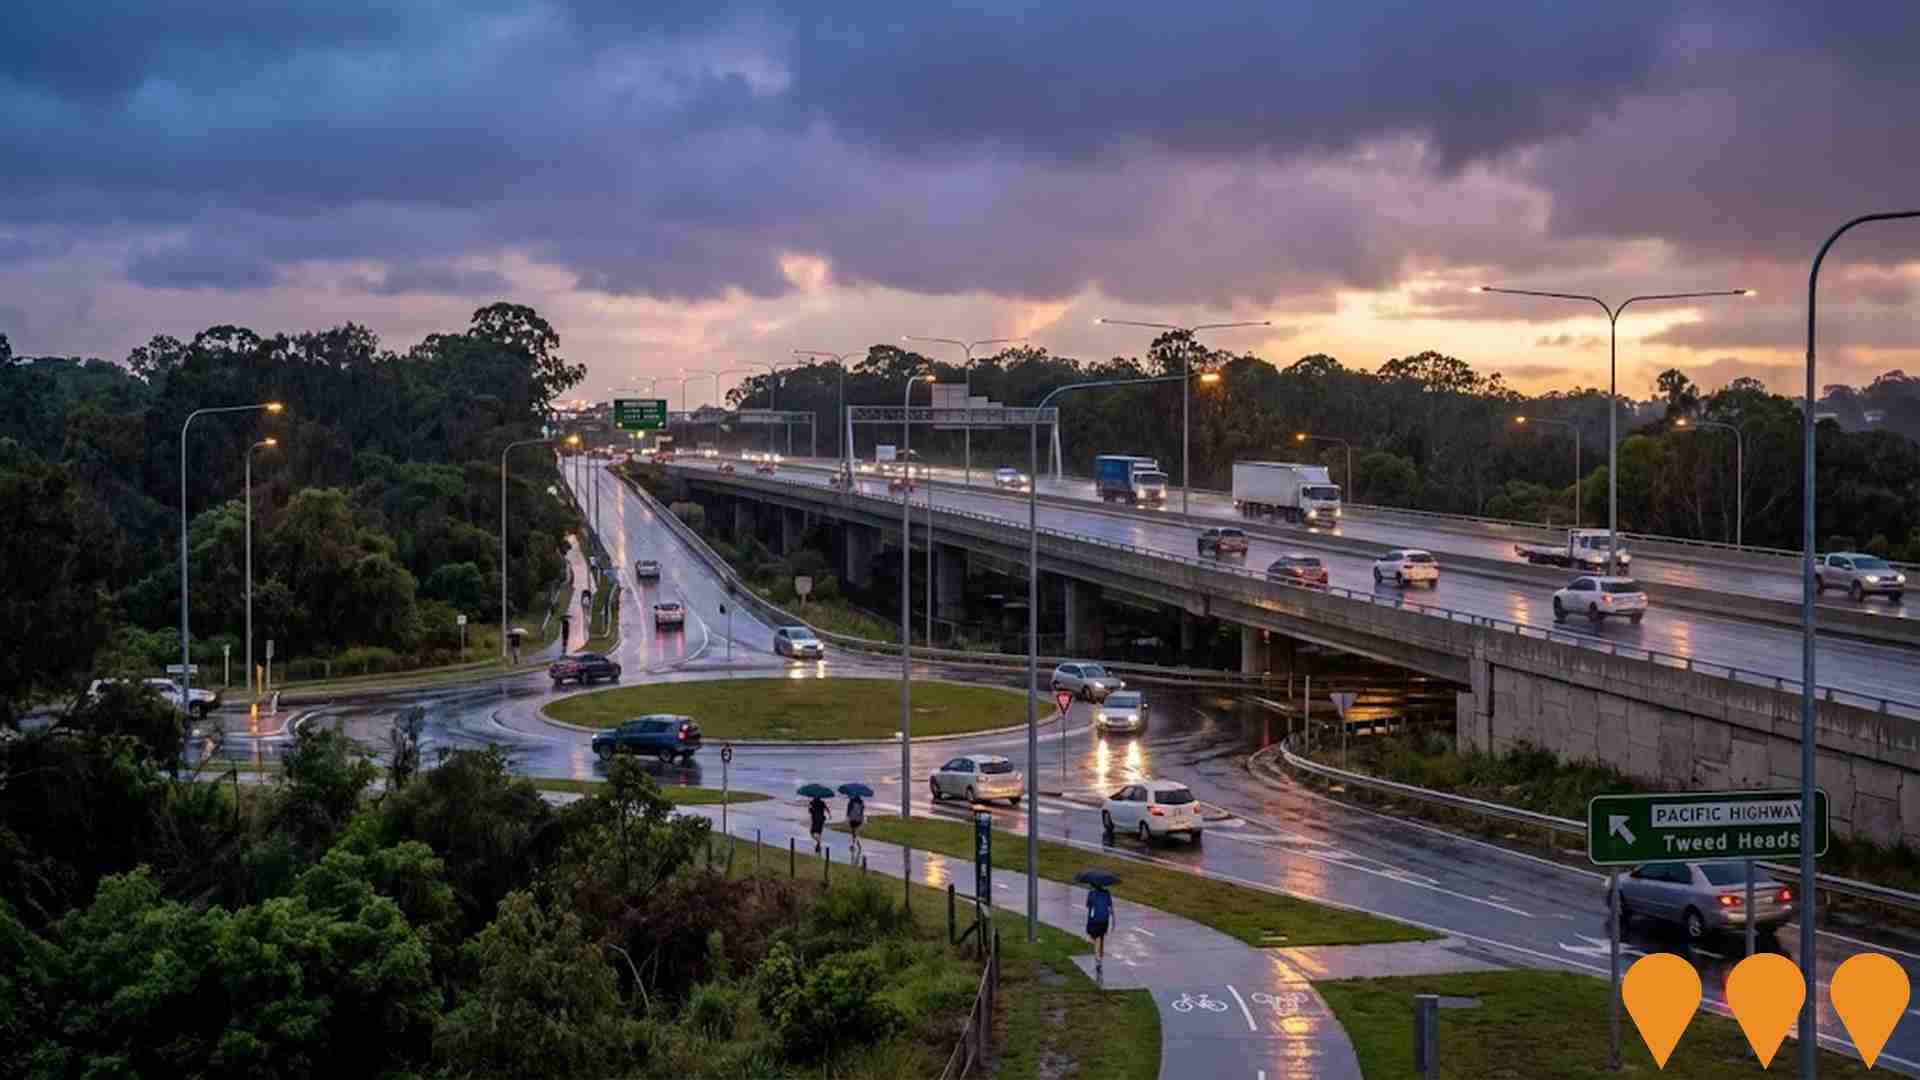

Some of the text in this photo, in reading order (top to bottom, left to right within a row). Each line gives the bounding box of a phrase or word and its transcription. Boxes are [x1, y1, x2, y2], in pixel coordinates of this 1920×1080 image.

[1656, 807, 1721, 822] PACIFIC
[1663, 831, 1800, 852] Tweed Heads
